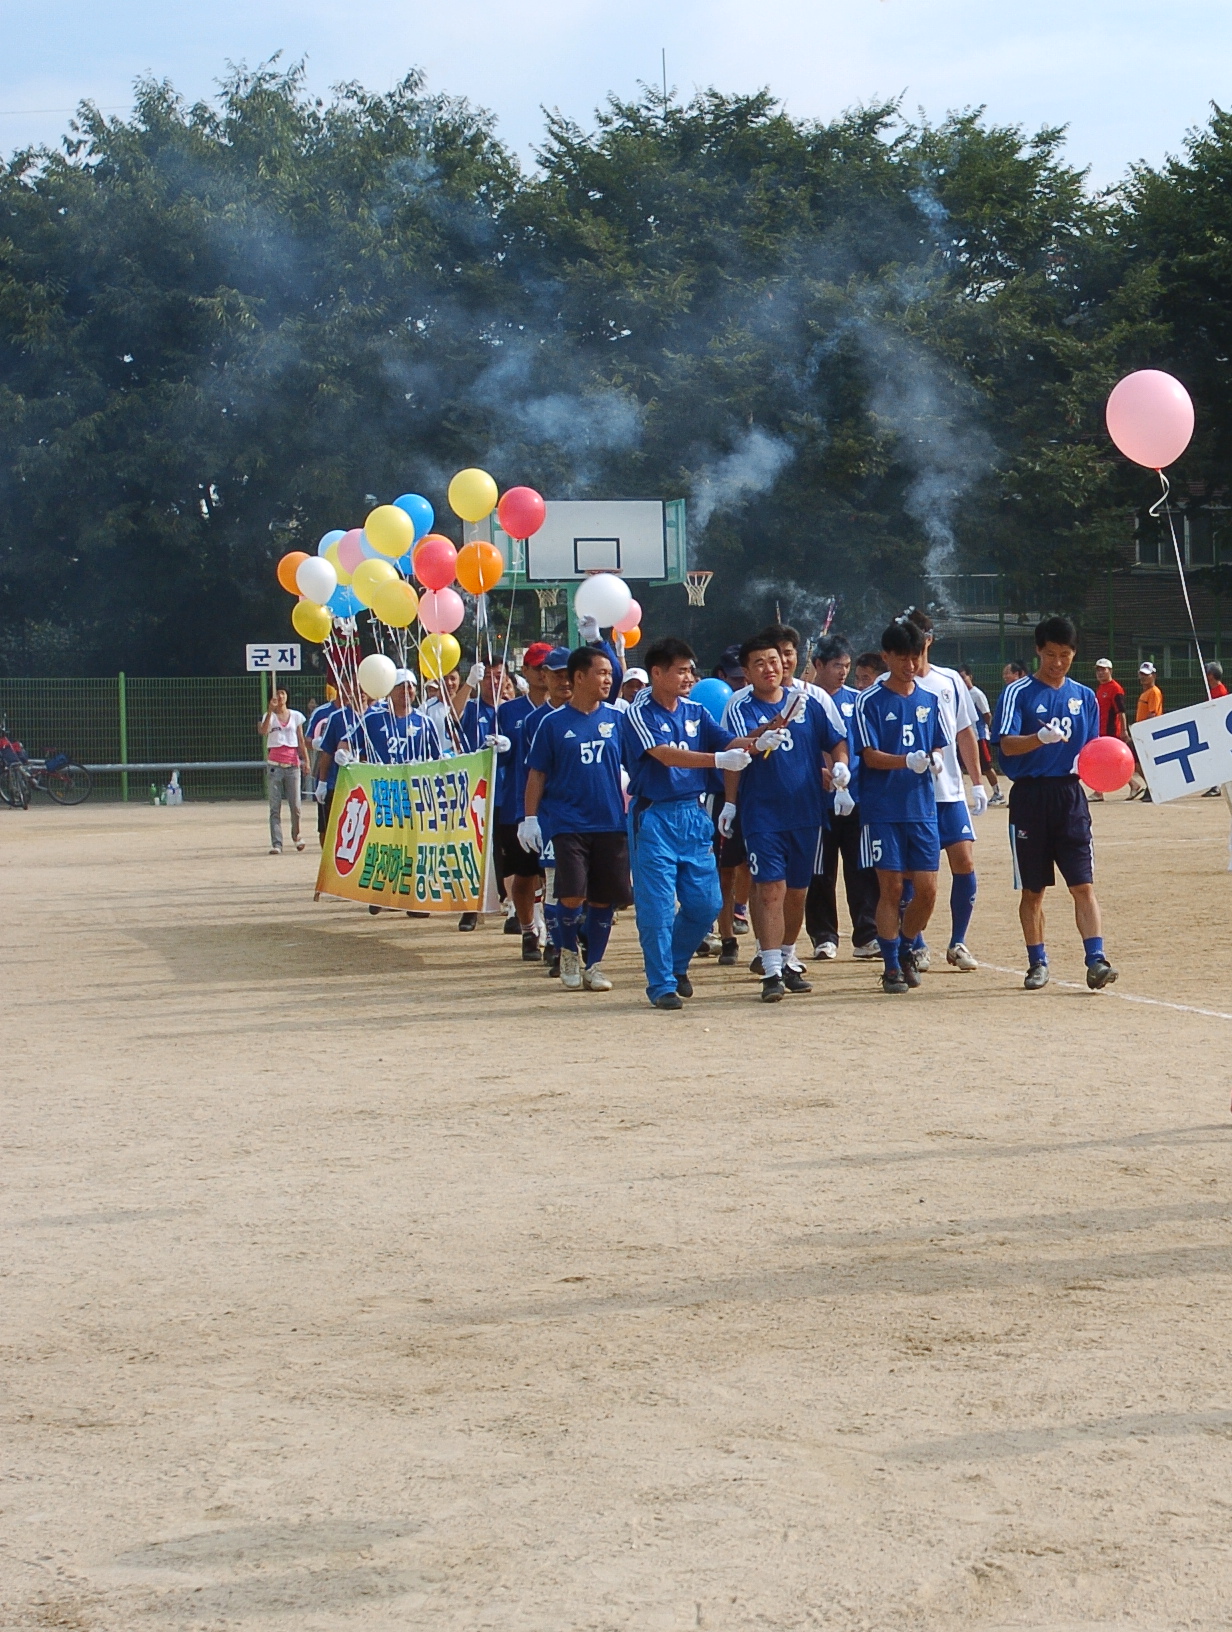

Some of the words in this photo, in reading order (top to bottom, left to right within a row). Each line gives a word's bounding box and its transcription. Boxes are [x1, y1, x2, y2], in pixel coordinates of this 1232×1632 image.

[251, 647, 297, 667] 군자
[387, 737, 408, 755] 27
[902, 724, 915, 747] 5
[580, 740, 606, 765] 57
[411, 768, 469, 834] 구의축구회
[872, 839, 883, 862] 5
[358, 841, 414, 896] 발전하는
[416, 841, 481, 902] 광진축구회
[749, 852, 759, 876] 3
